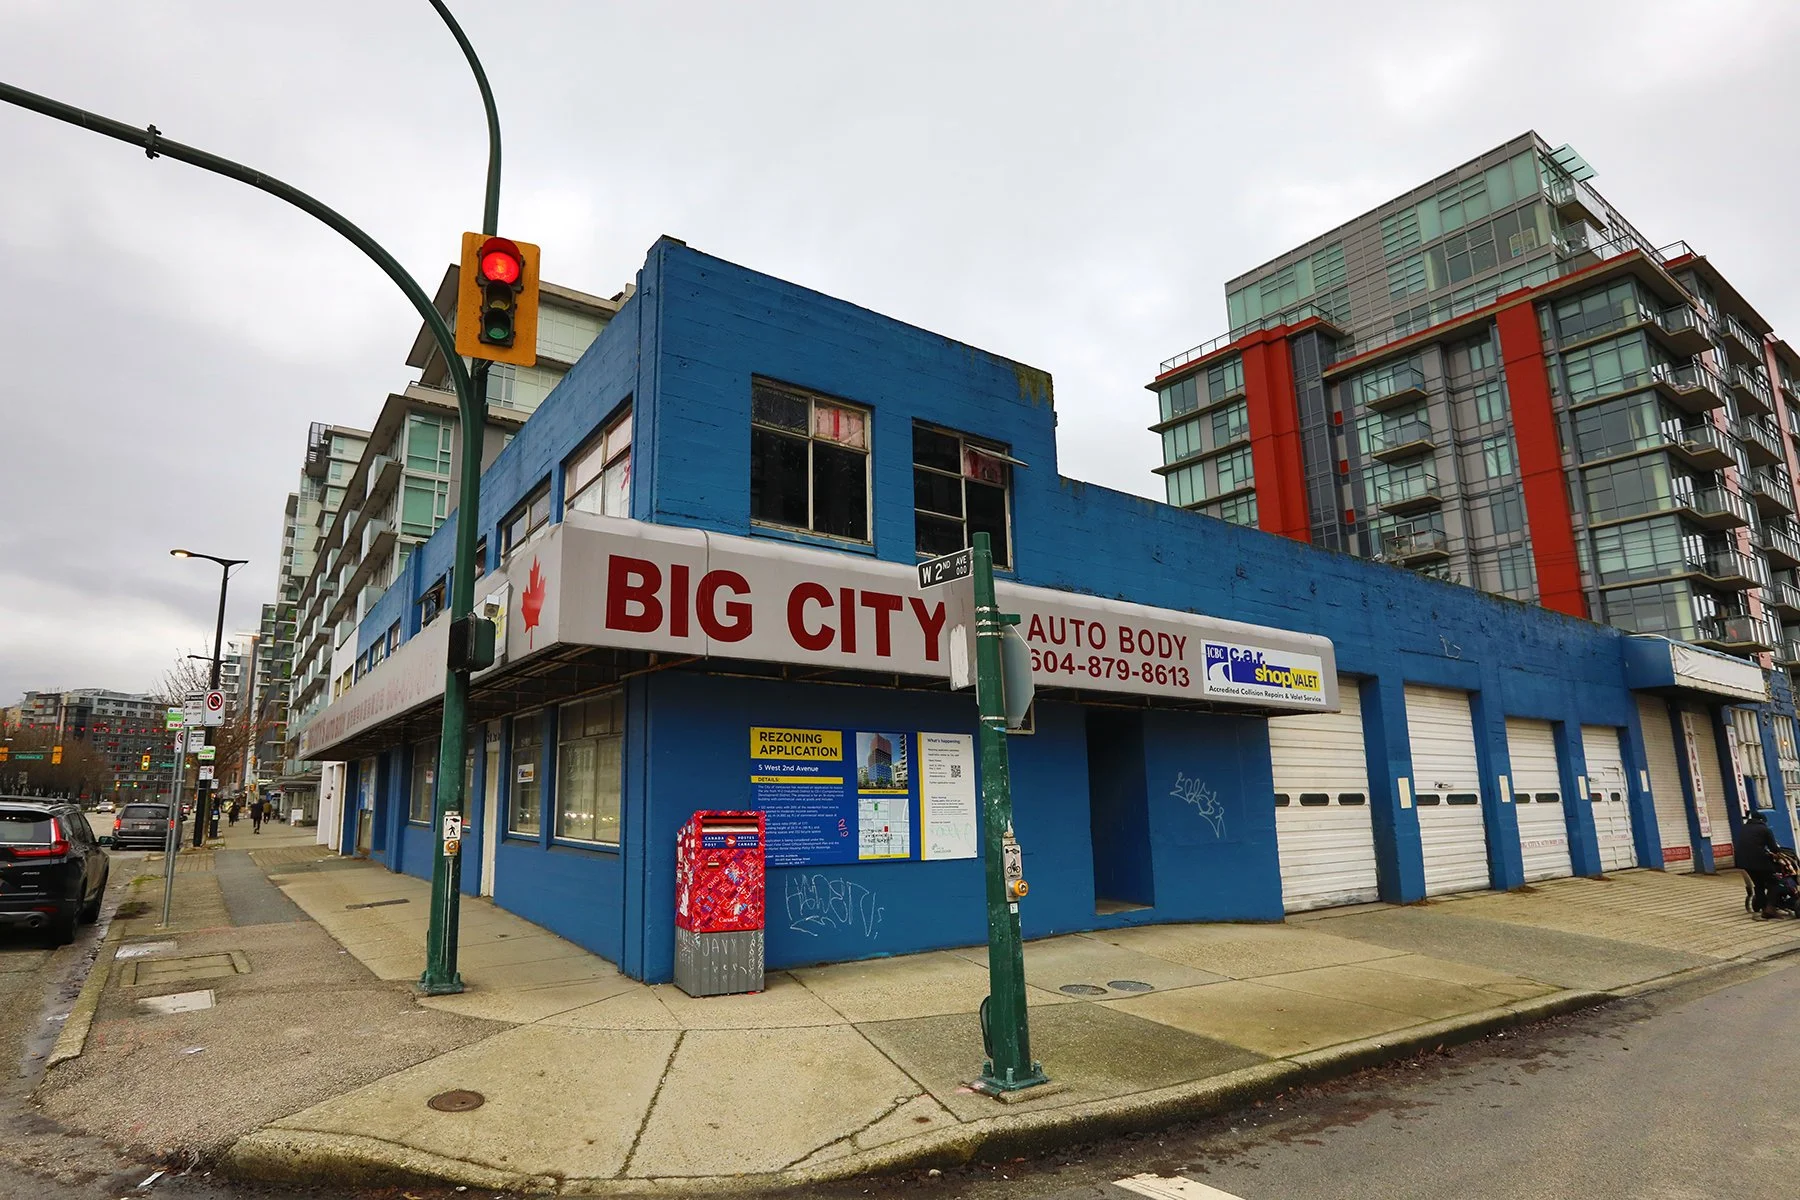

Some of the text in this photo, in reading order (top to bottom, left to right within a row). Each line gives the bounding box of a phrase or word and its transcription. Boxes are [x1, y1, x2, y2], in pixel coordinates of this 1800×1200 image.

[922, 555, 967, 584] W 2ND AVE
[605, 554, 753, 643] BIG
[786, 581, 947, 662] CITY
[1027, 613, 1187, 661] AUTO BODY
[1206, 646, 1225, 659] ICBC
[1030, 648, 1190, 688] 604-879-8613
[1255, 664, 1318, 689] shop VALET
[1209, 685, 1240, 695] Accredited
[1240, 687, 1264, 697] Collision
[1264, 690, 1284, 700] Repairs
[1303, 695, 1322, 703] Service
[759, 731, 823, 744] REZONING
[759, 744, 838, 757] APPLICATION
[782, 764, 795, 772] 2nd
